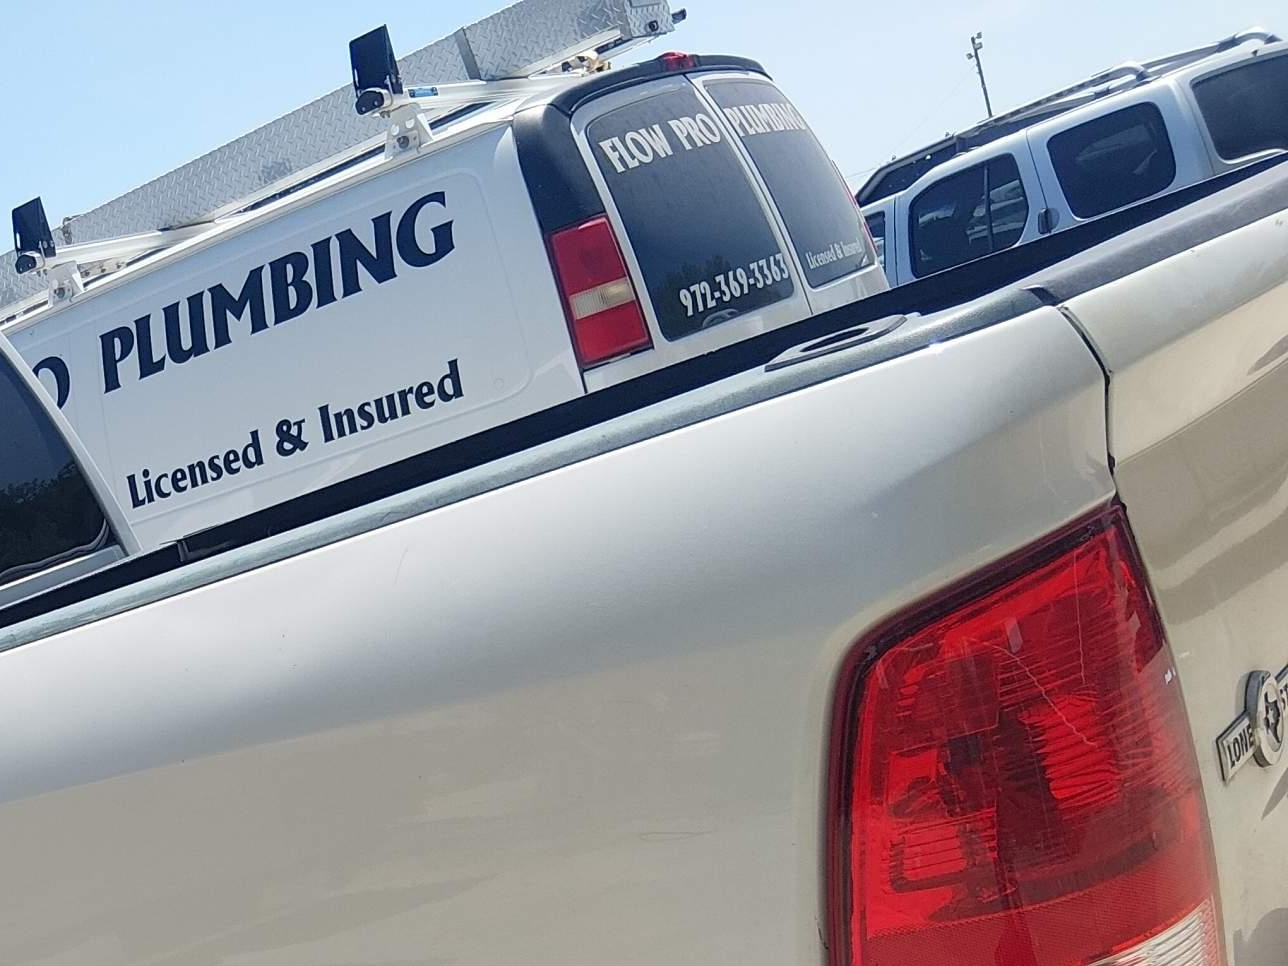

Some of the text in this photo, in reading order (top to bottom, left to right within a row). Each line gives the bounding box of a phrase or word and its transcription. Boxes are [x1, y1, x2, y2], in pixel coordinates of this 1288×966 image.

[598, 103, 808, 174] FLOW PRO PLUMBING
[679, 253, 789, 317] 972-369-3363
[805, 244, 837, 270] Licensed
[833, 242, 844, 260] &
[99, 191, 455, 394] PLUMBING
[126, 359, 464, 508] Licensed & Insured
[1226, 721, 1255, 770] LONE
